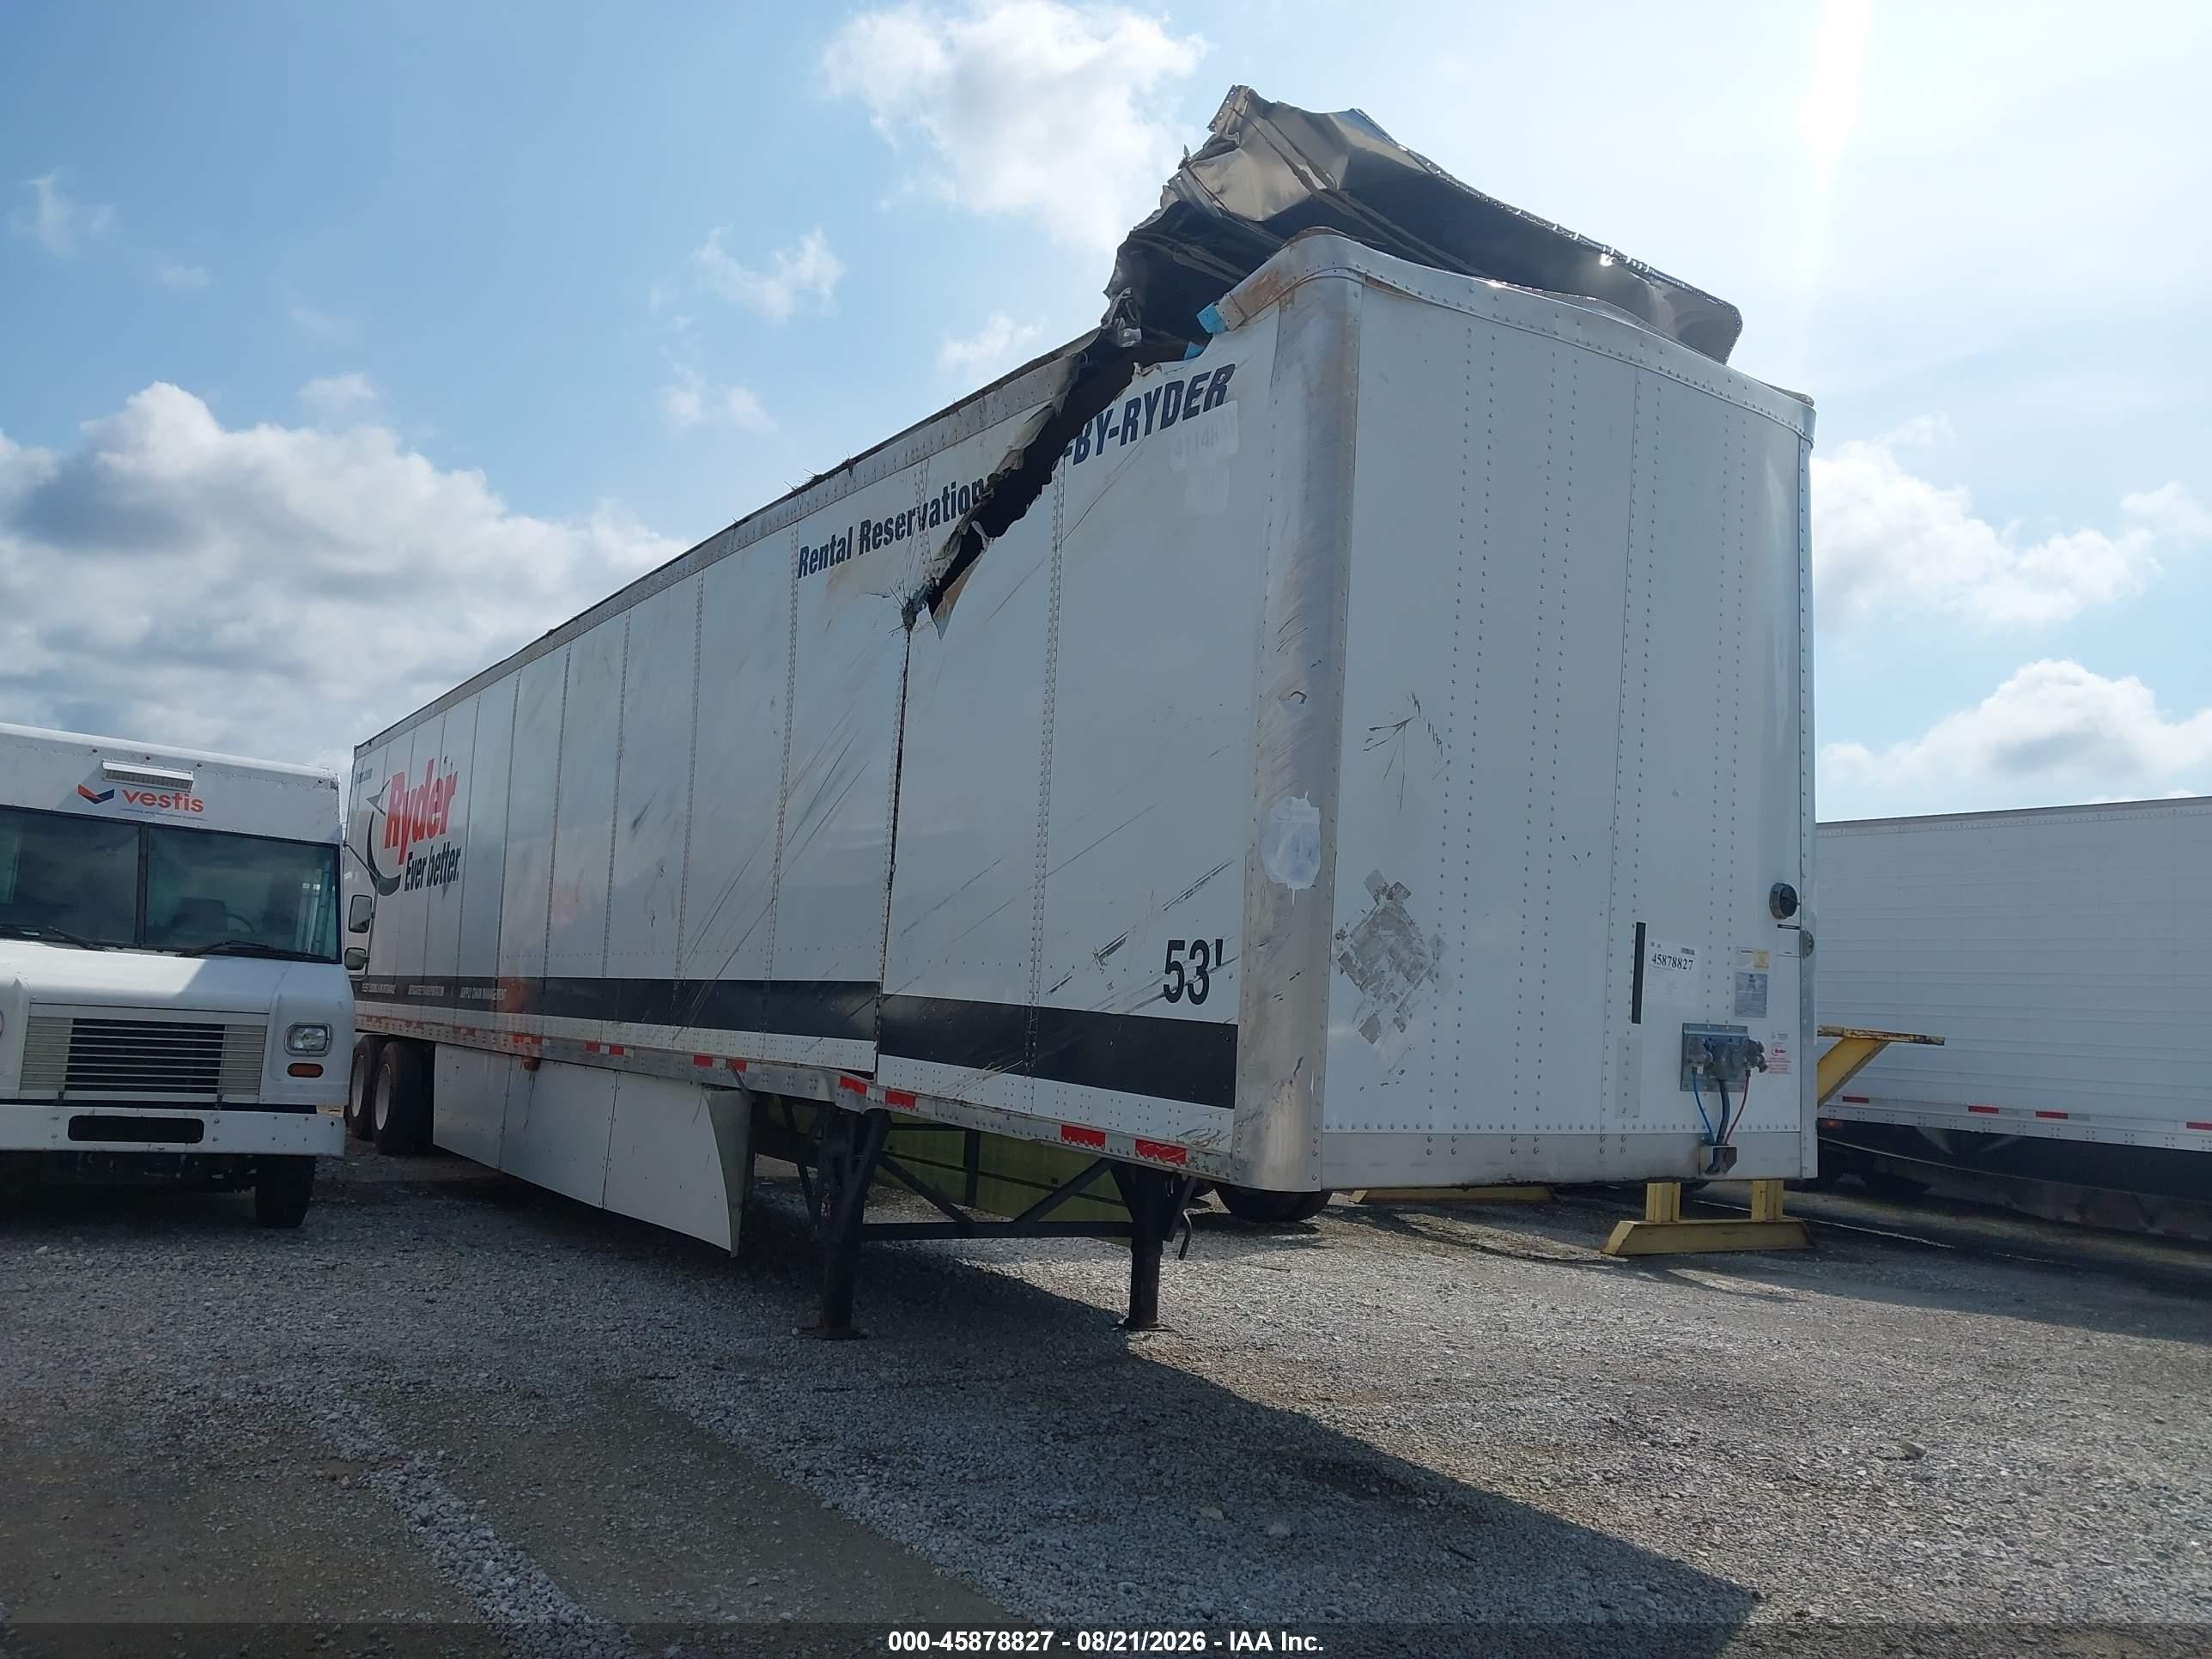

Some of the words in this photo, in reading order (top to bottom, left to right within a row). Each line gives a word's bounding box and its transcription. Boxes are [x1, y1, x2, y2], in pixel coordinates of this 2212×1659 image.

[798, 526, 854, 579] Rental
[122, 789, 204, 813] vestis
[384, 758, 459, 866] Ryder
[404, 851, 428, 892] Ever
[426, 841, 462, 889] better.
[1163, 939, 1224, 1006] 53'
[1651, 952, 1694, 971] 45878827
